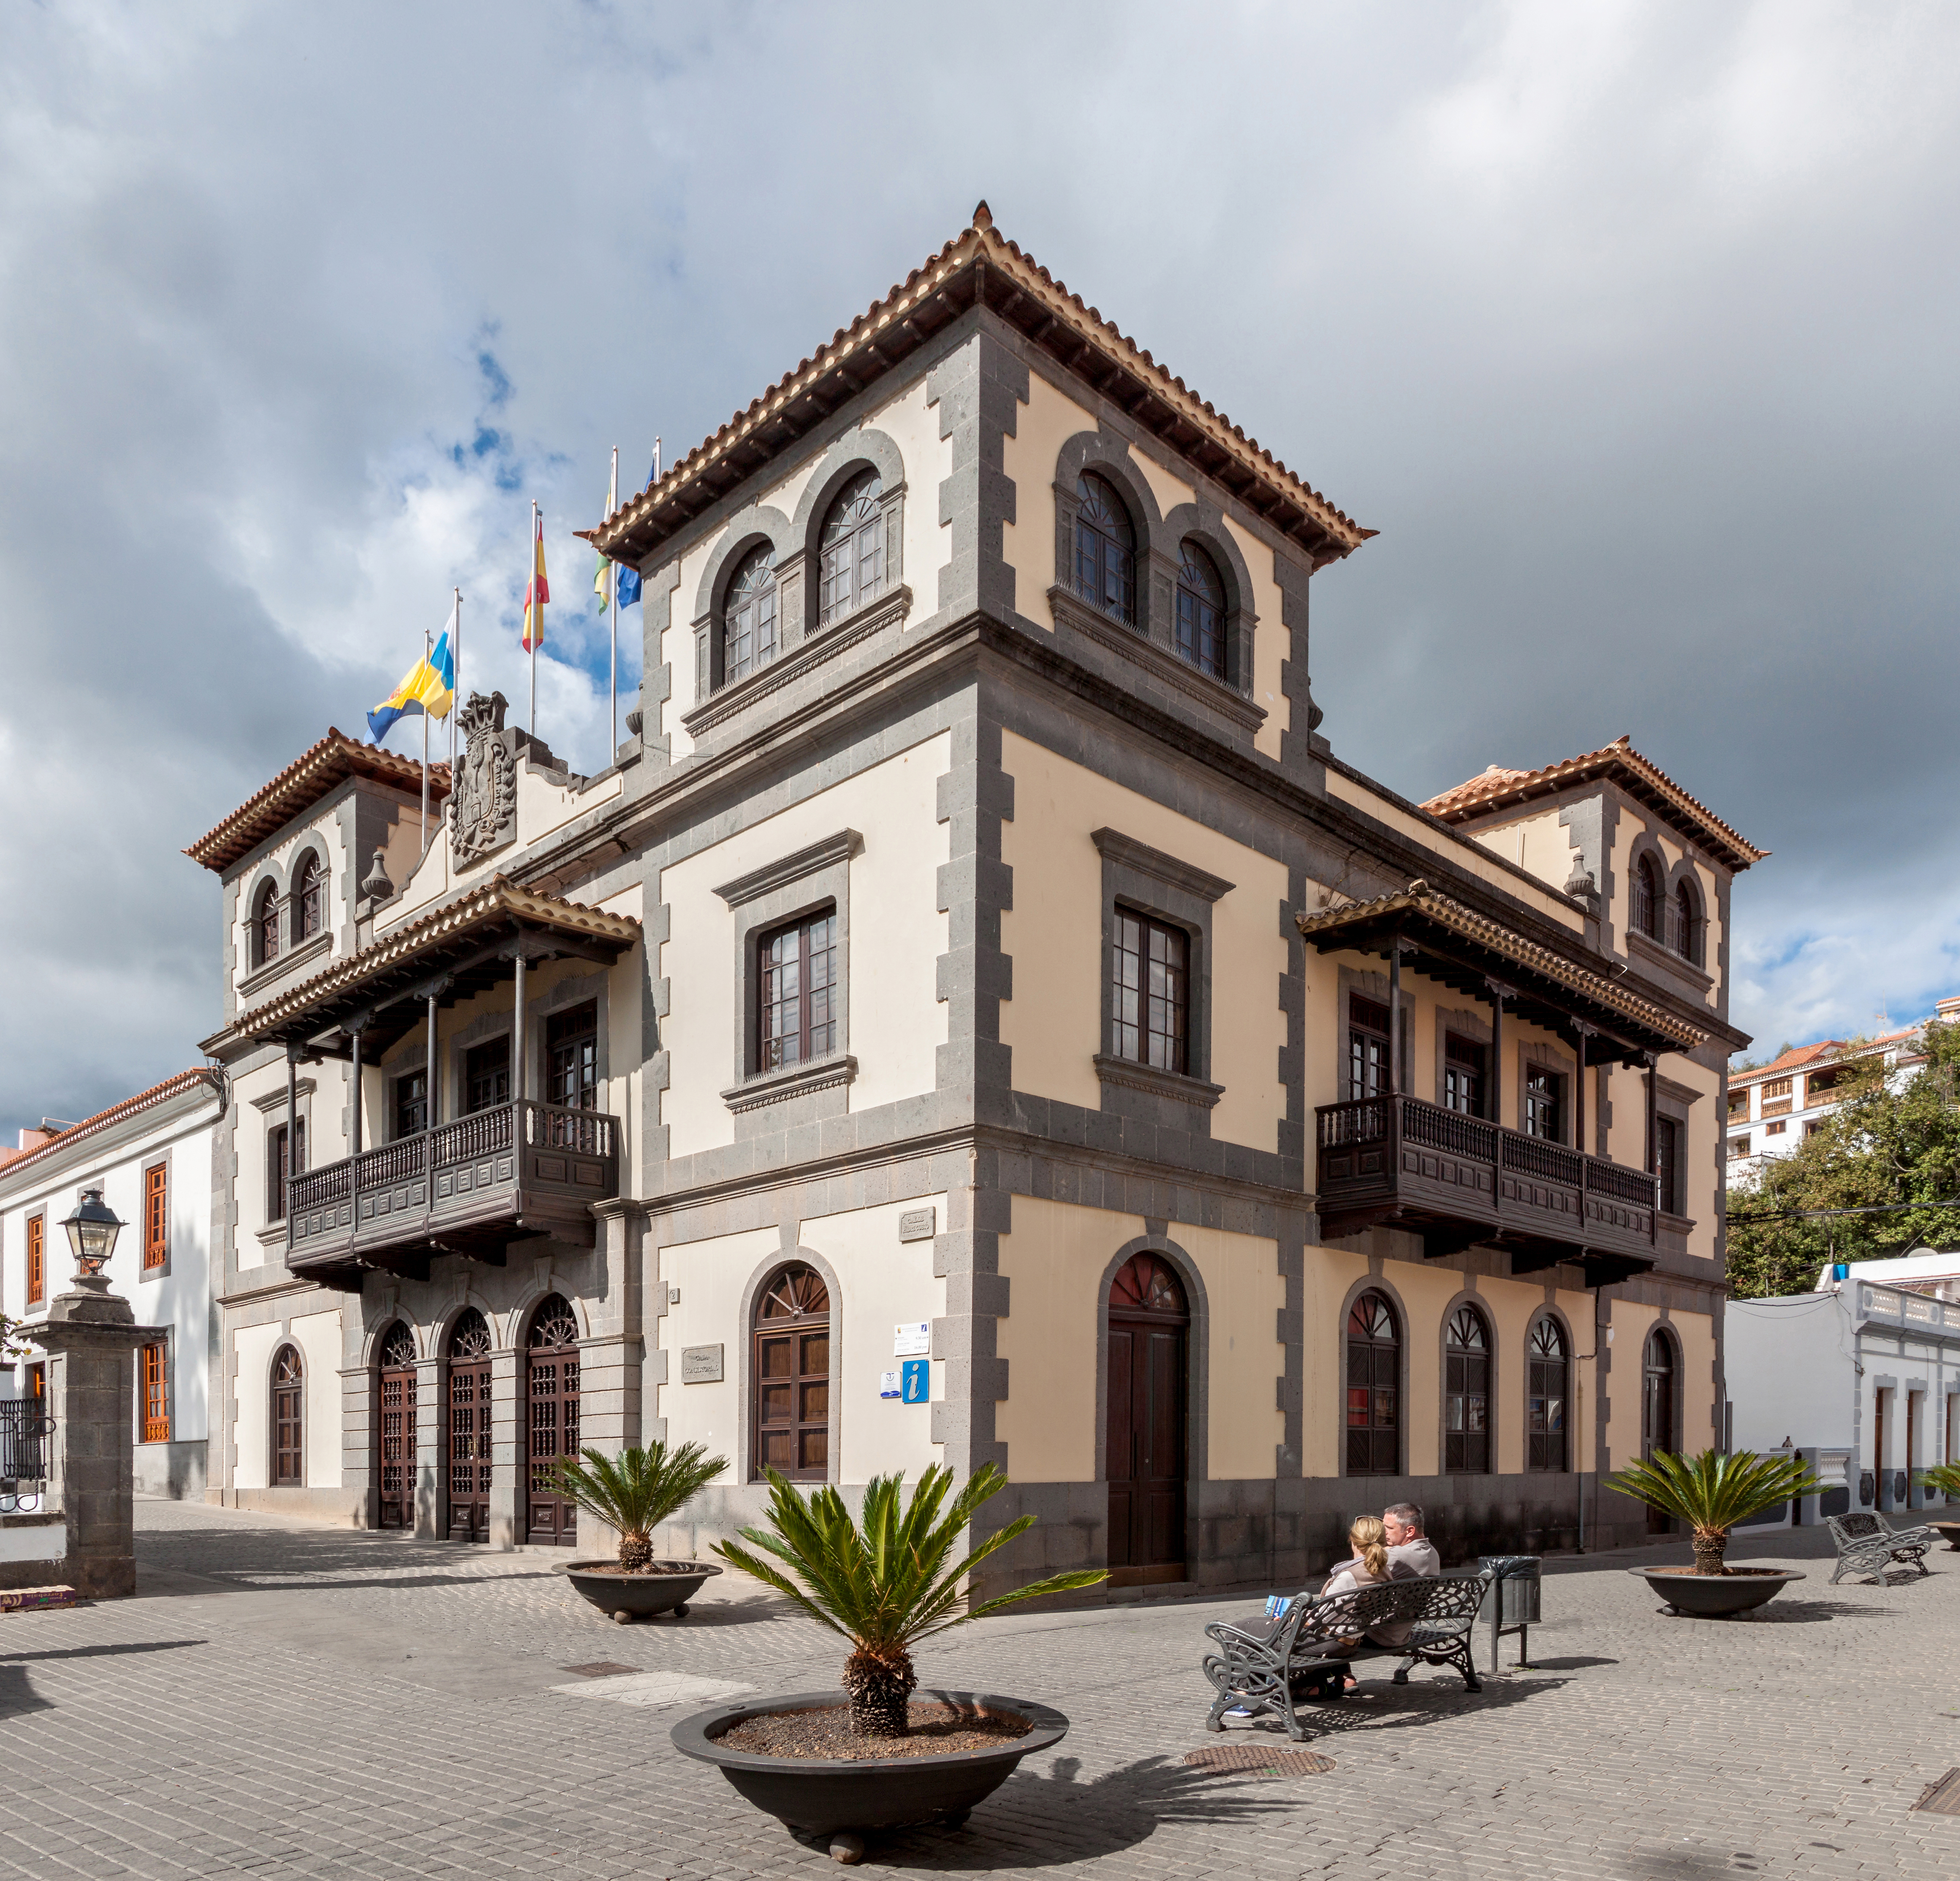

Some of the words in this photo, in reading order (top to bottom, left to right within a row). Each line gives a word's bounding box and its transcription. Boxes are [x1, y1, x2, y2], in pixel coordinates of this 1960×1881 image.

[908, 1216, 924, 1224] CALLE
[902, 1225, 916, 1234] PADRE
[685, 1365, 719, 1374] CONSISTORIAL
[906, 1363, 921, 1401] i
